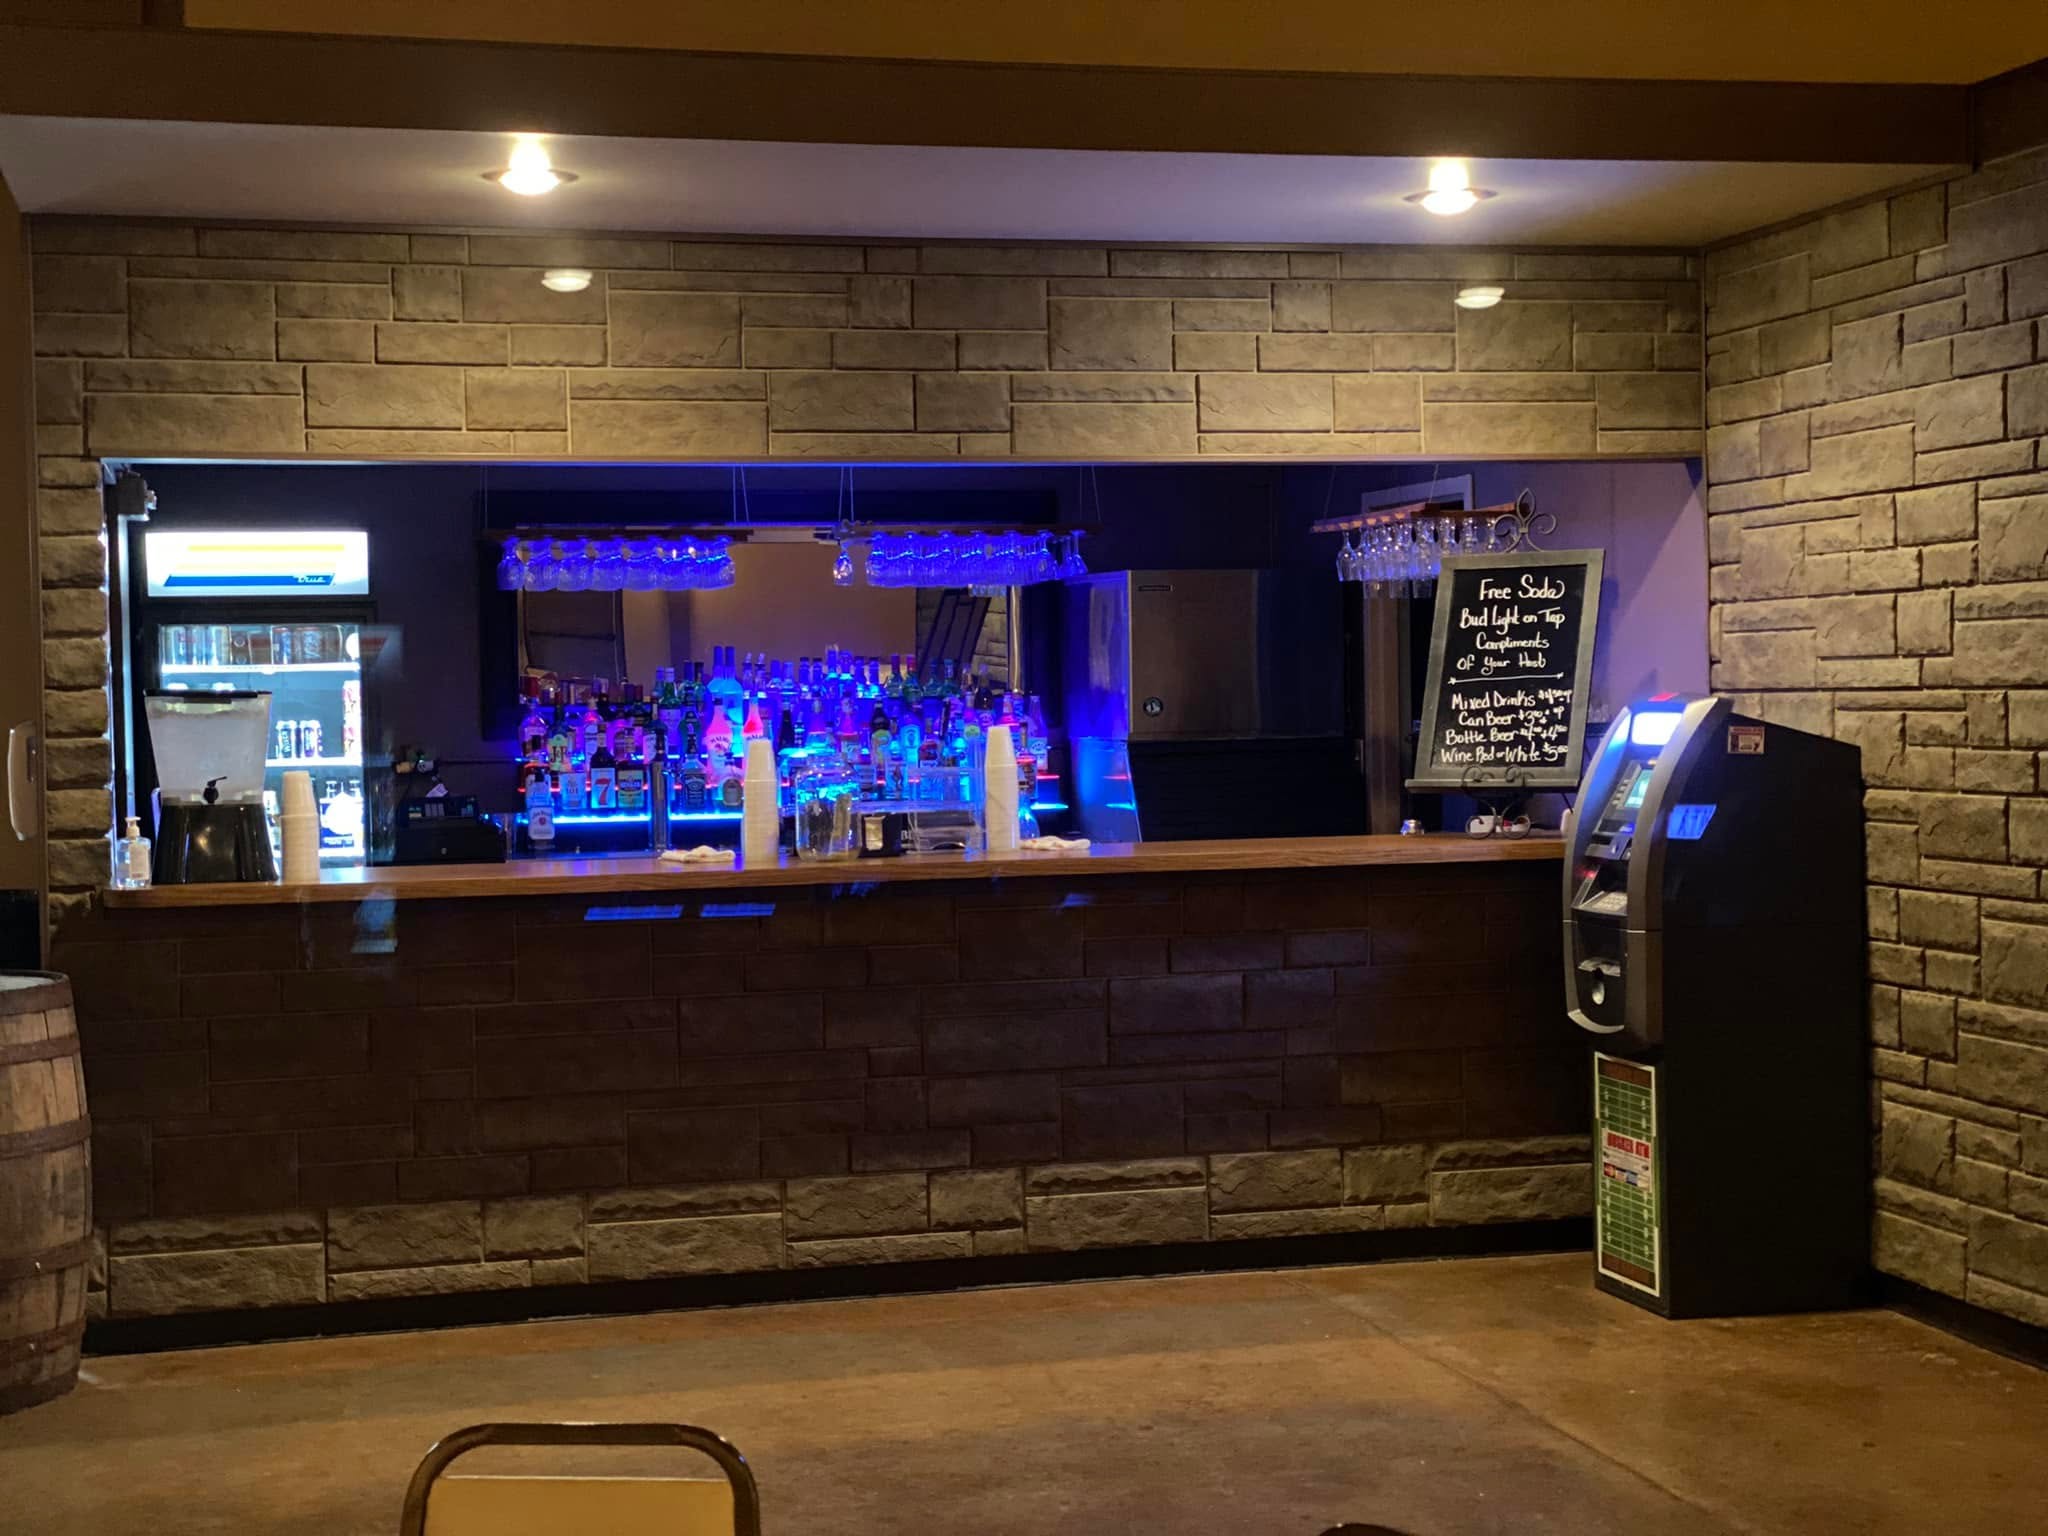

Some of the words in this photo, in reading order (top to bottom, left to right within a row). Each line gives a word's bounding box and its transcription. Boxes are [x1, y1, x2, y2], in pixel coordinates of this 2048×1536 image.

[1480, 578, 1511, 600] Free
[1518, 574, 1565, 599] Soda
[1460, 607, 1488, 629] Bud
[1522, 614, 1538, 623] on
[1537, 606, 1565, 630] Tap
[1476, 631, 1550, 654] Compliments
[1519, 651, 1546, 668] Host
[1452, 691, 1490, 710] Mixed
[1493, 690, 1536, 708] Drinks
[1458, 711, 1484, 726] Can
[1486, 710, 1517, 726] Beer
[1446, 729, 1487, 745] Bottle
[1490, 727, 1519, 742] Beer
[1441, 748, 1473, 762] Wine
[1476, 746, 1495, 763] Red
[1505, 741, 1541, 762] White
[595, 777, 611, 806] 7
